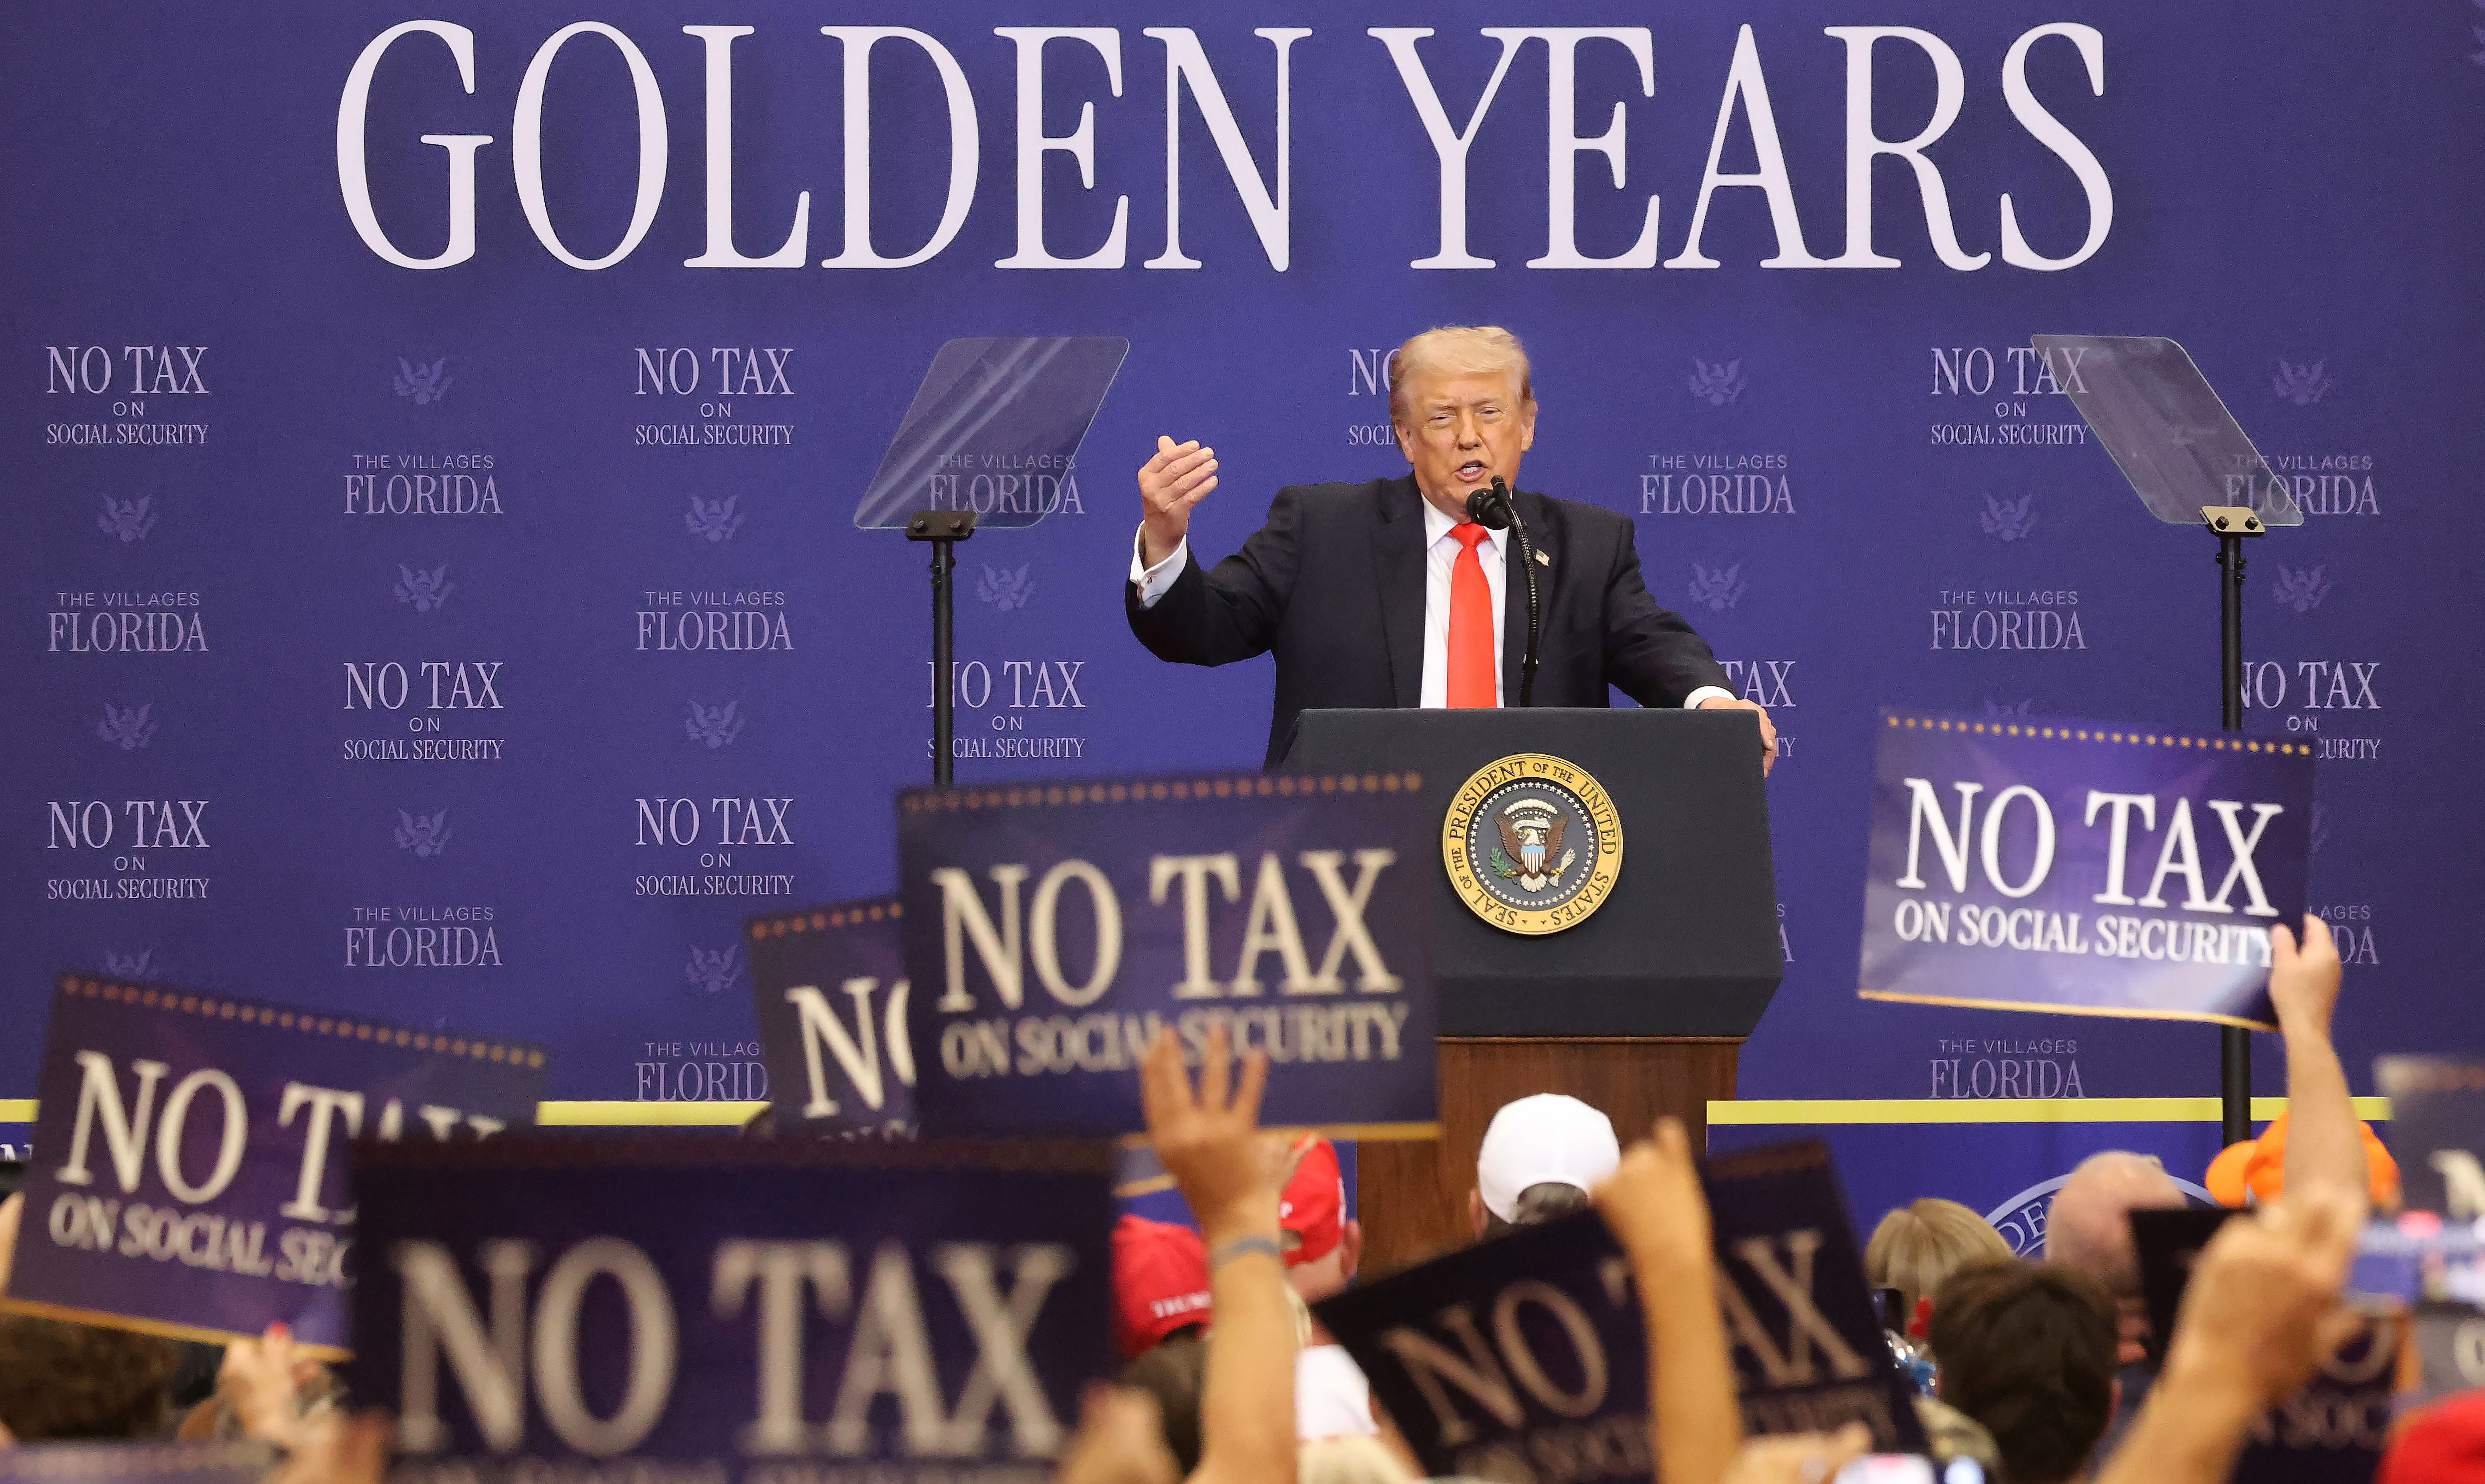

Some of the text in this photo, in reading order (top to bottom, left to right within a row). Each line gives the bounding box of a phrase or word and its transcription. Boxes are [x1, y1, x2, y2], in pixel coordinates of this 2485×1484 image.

[337, 20, 2115, 272] GOLDEN YEARS
[46, 346, 209, 393] NO TAX
[635, 347, 794, 394] NO TAX
[1931, 347, 2089, 394] NO TAX
[113, 402, 143, 416] ON
[701, 403, 730, 417] ON
[1995, 402, 2025, 417] ON
[47, 424, 209, 444] SOCIAL SECURITY
[636, 425, 794, 444] SOCIAL SECURITY
[1932, 424, 2088, 444] SOCIAL SECURITY
[353, 455, 493, 468] THE VILLAGES
[937, 455, 1076, 469] THE VILLAGES
[1649, 455, 1787, 469] THE VILLAGES
[2278, 455, 2371, 470] VILLAGES
[344, 475, 503, 514] FLORIDA
[930, 474, 1085, 514] FLORIDA
[1640, 475, 1795, 514] FLORIDA
[2223, 475, 2380, 515] FLORIDA
[57, 593, 199, 606] THE VILLAGES
[646, 592, 784, 605] THE VILLAGES
[1940, 591, 2078, 605] THE VILLAGES
[48, 612, 209, 651] FLORIDA
[636, 611, 794, 650] FLORIDA
[1931, 610, 2087, 649] FLORIDA
[344, 662, 504, 709] NO TAX
[1004, 661, 1085, 707] TAX
[2299, 661, 2381, 709] TAX
[409, 717, 439, 731] ON
[992, 716, 1022, 730] ON
[2287, 717, 2318, 731] ON
[345, 740, 504, 759] SOCIAL SECURITY
[928, 738, 1085, 758] SCIAL SECURITY
[47, 801, 210, 848] NO TAX
[636, 798, 794, 845] NO TAX
[701, 853, 730, 867] ON
[1449, 760, 1617, 926] SEAL OF THE PRESIDENT OF THE UNITED STATES
[1897, 777, 2284, 917] NO TAX
[114, 857, 144, 871] ON
[48, 879, 209, 899] SOCIAL SECURITY
[636, 875, 794, 895] SOCIAL SECURITY
[354, 907, 493, 921] THE VILLAGES
[933, 849, 1400, 1011] NO TAX
[1894, 898, 1952, 943] ON
[1956, 904, 2090, 955] SOCIAL
[345, 927, 503, 966] FLORIDA
[645, 1043, 681, 1056] THE
[941, 1018, 1010, 1079] ON
[1179, 1001, 1409, 1064] SCURITY
[1939, 1039, 2077, 1054] THE VILLAGES
[1930, 1059, 2086, 1099] FLORIDA
[55, 1050, 248, 1203] NO
[48, 1193, 121, 1252] ON
[119, 1200, 275, 1278] SOCIAL
[398, 1237, 1077, 1458] NO TAX
[1382, 1279, 1609, 1447] NO
